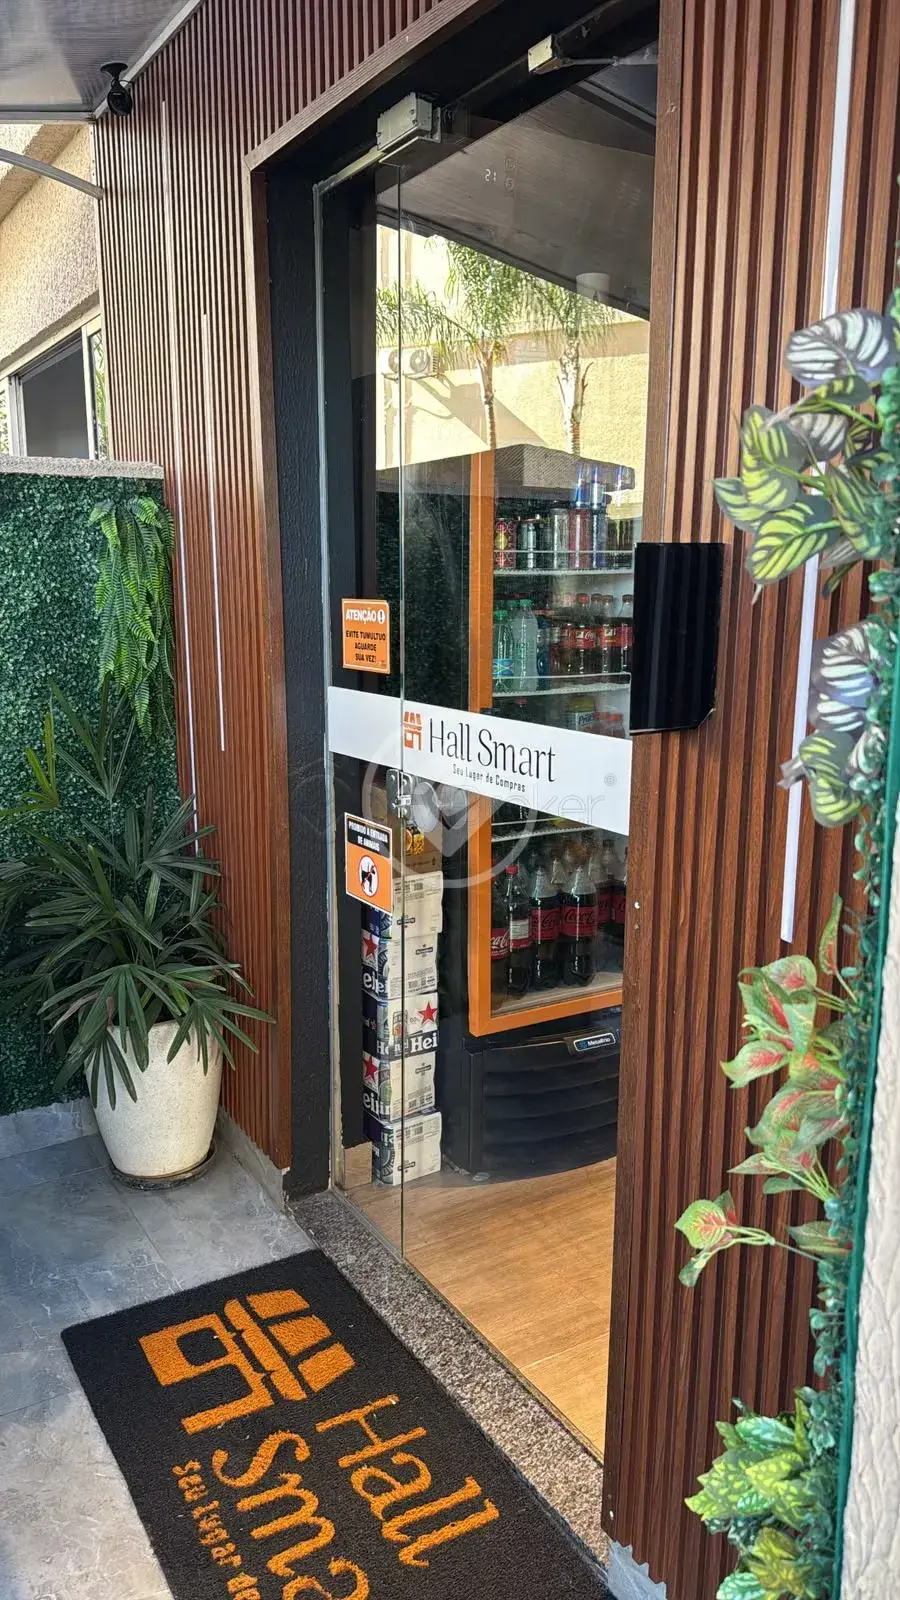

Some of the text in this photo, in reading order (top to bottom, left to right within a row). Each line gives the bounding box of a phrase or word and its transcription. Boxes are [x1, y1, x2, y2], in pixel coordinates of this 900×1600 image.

[346, 607, 377, 624] ATENÇÃO
[345, 630, 359, 638] EVITE
[354, 642, 377, 652] AGUARDE
[355, 653, 365, 661] SUA
[429, 717, 556, 782] Hall Smart
[452, 763, 526, 792] Seu Lugar de Compras
[315, 1394, 500, 1567] Hall
